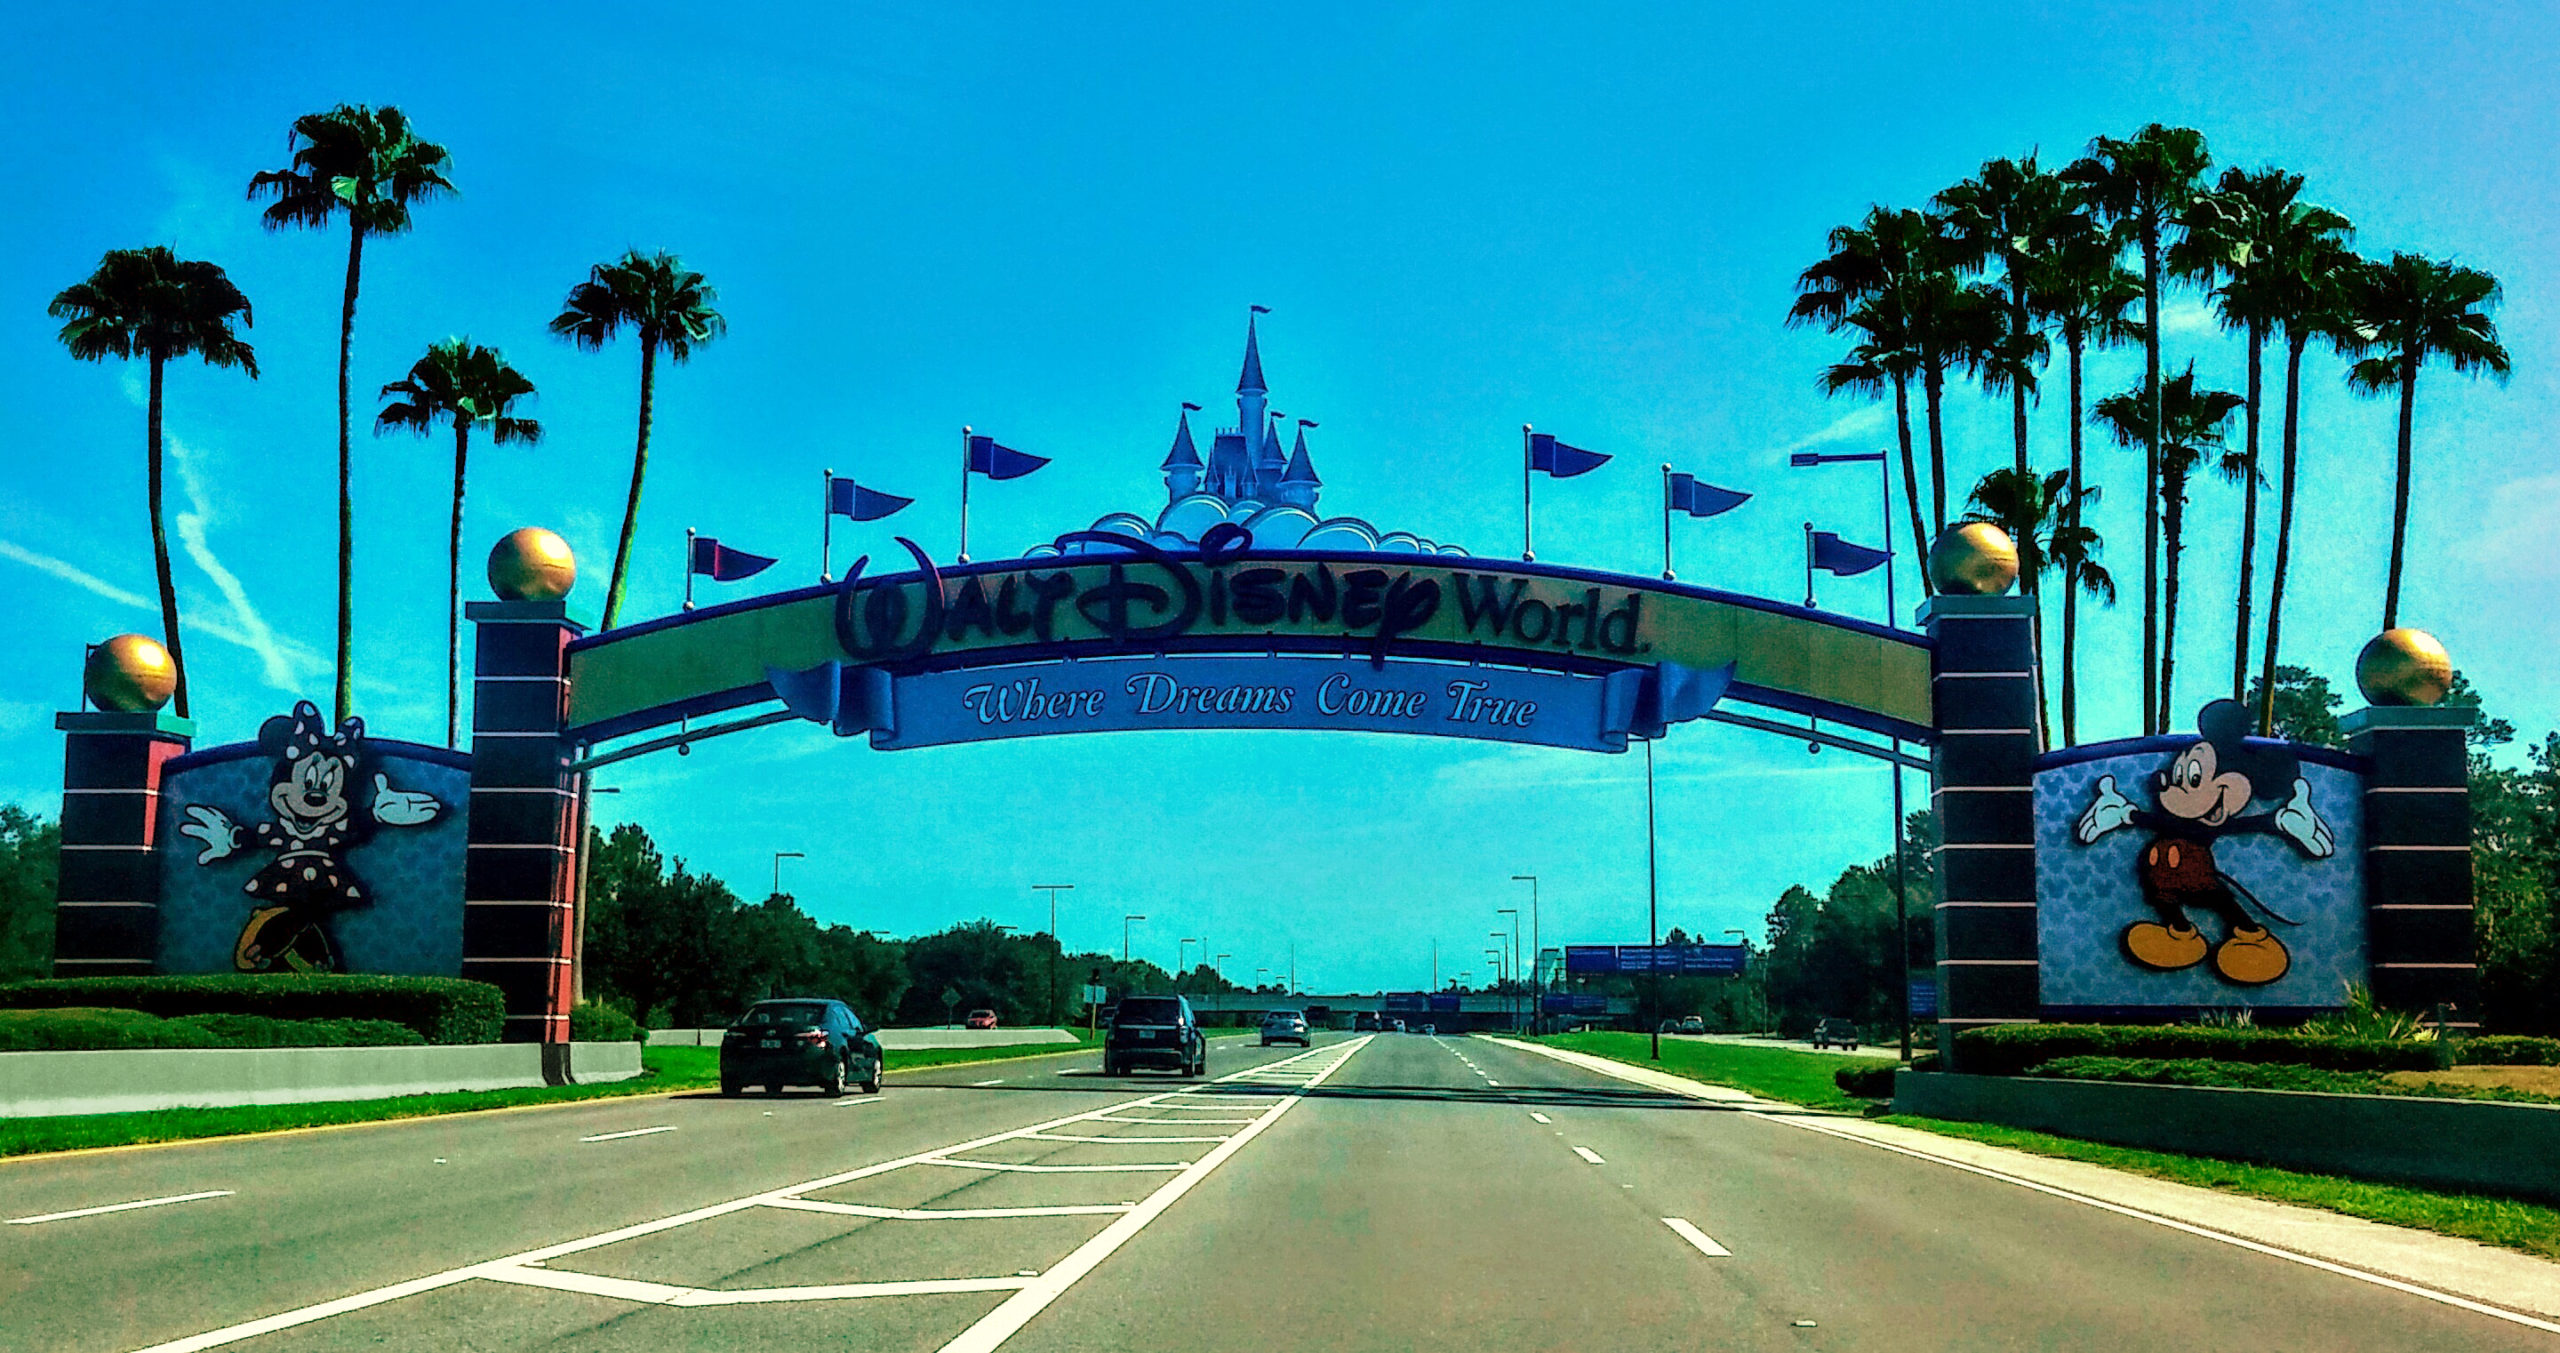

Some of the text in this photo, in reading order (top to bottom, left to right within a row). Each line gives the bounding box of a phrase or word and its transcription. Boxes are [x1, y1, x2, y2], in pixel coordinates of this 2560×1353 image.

[963, 672, 1538, 728] Where Dreams Come True
